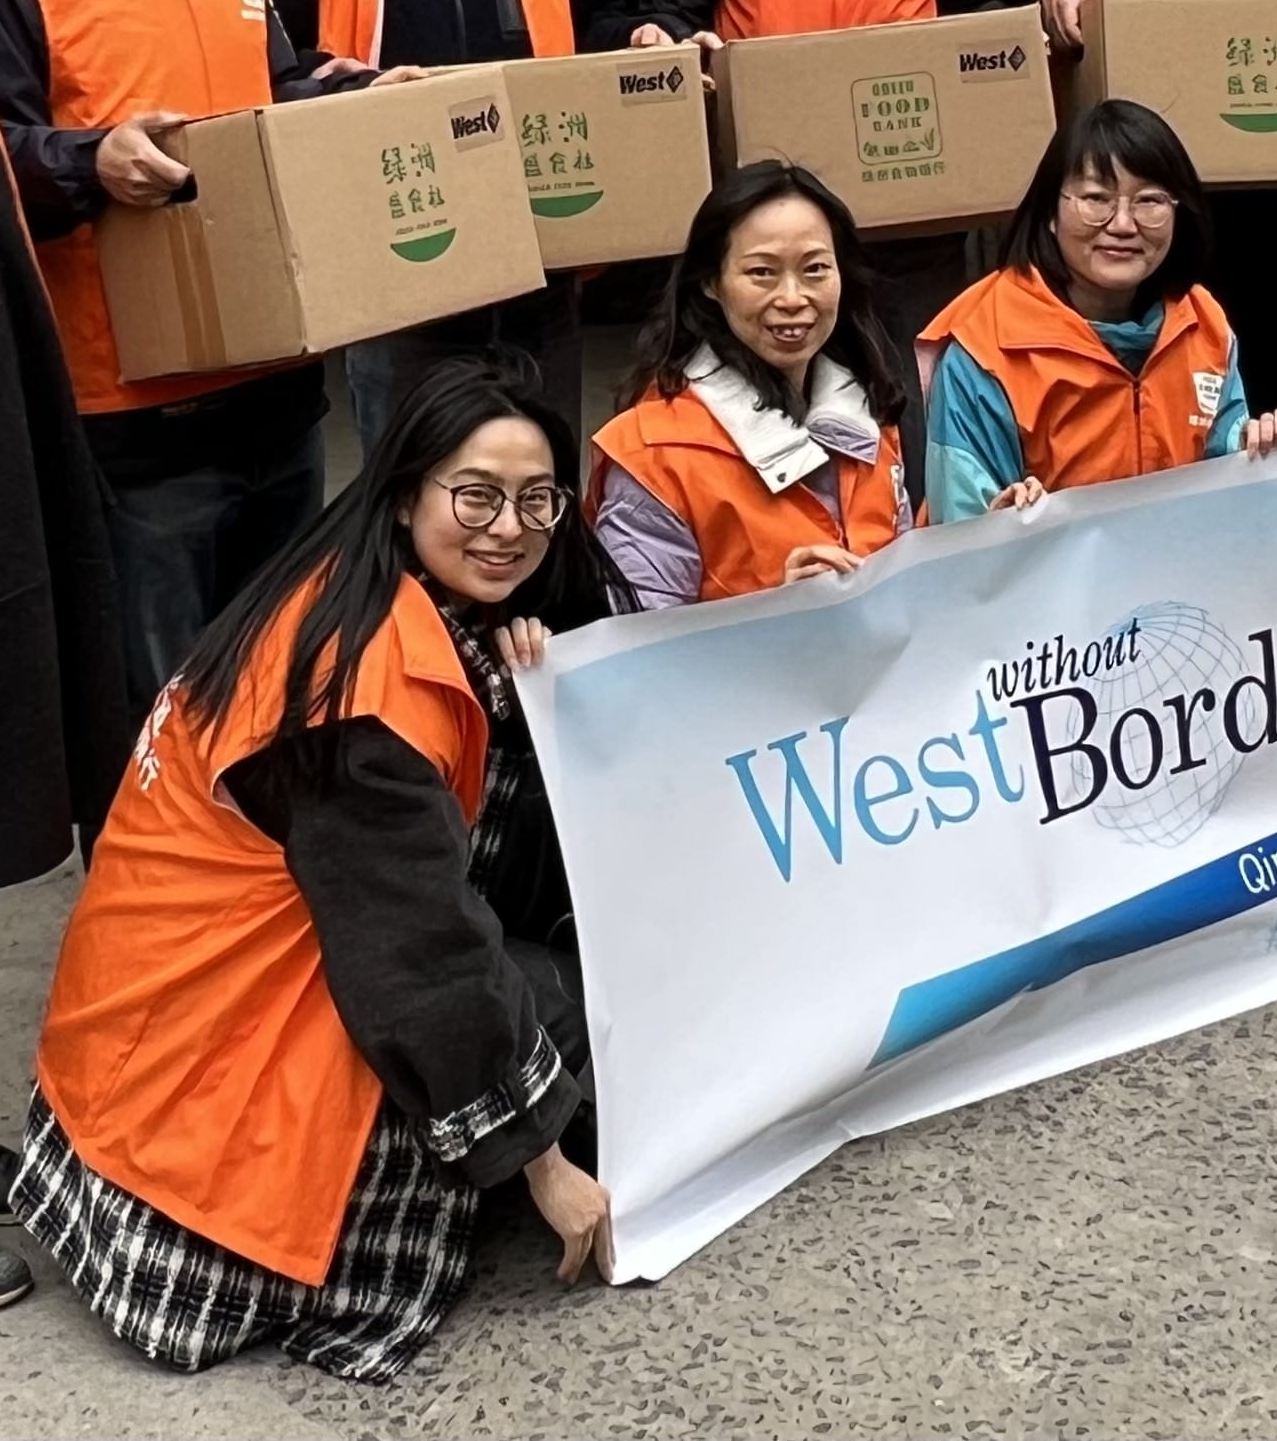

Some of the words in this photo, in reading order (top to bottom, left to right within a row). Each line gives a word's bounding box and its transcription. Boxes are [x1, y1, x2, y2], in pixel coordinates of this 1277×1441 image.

[959, 50, 1007, 73] West
[619, 72, 666, 96] West
[451, 111, 488, 141] West
[724, 687, 1025, 884] West
[986, 616, 1143, 700] without
